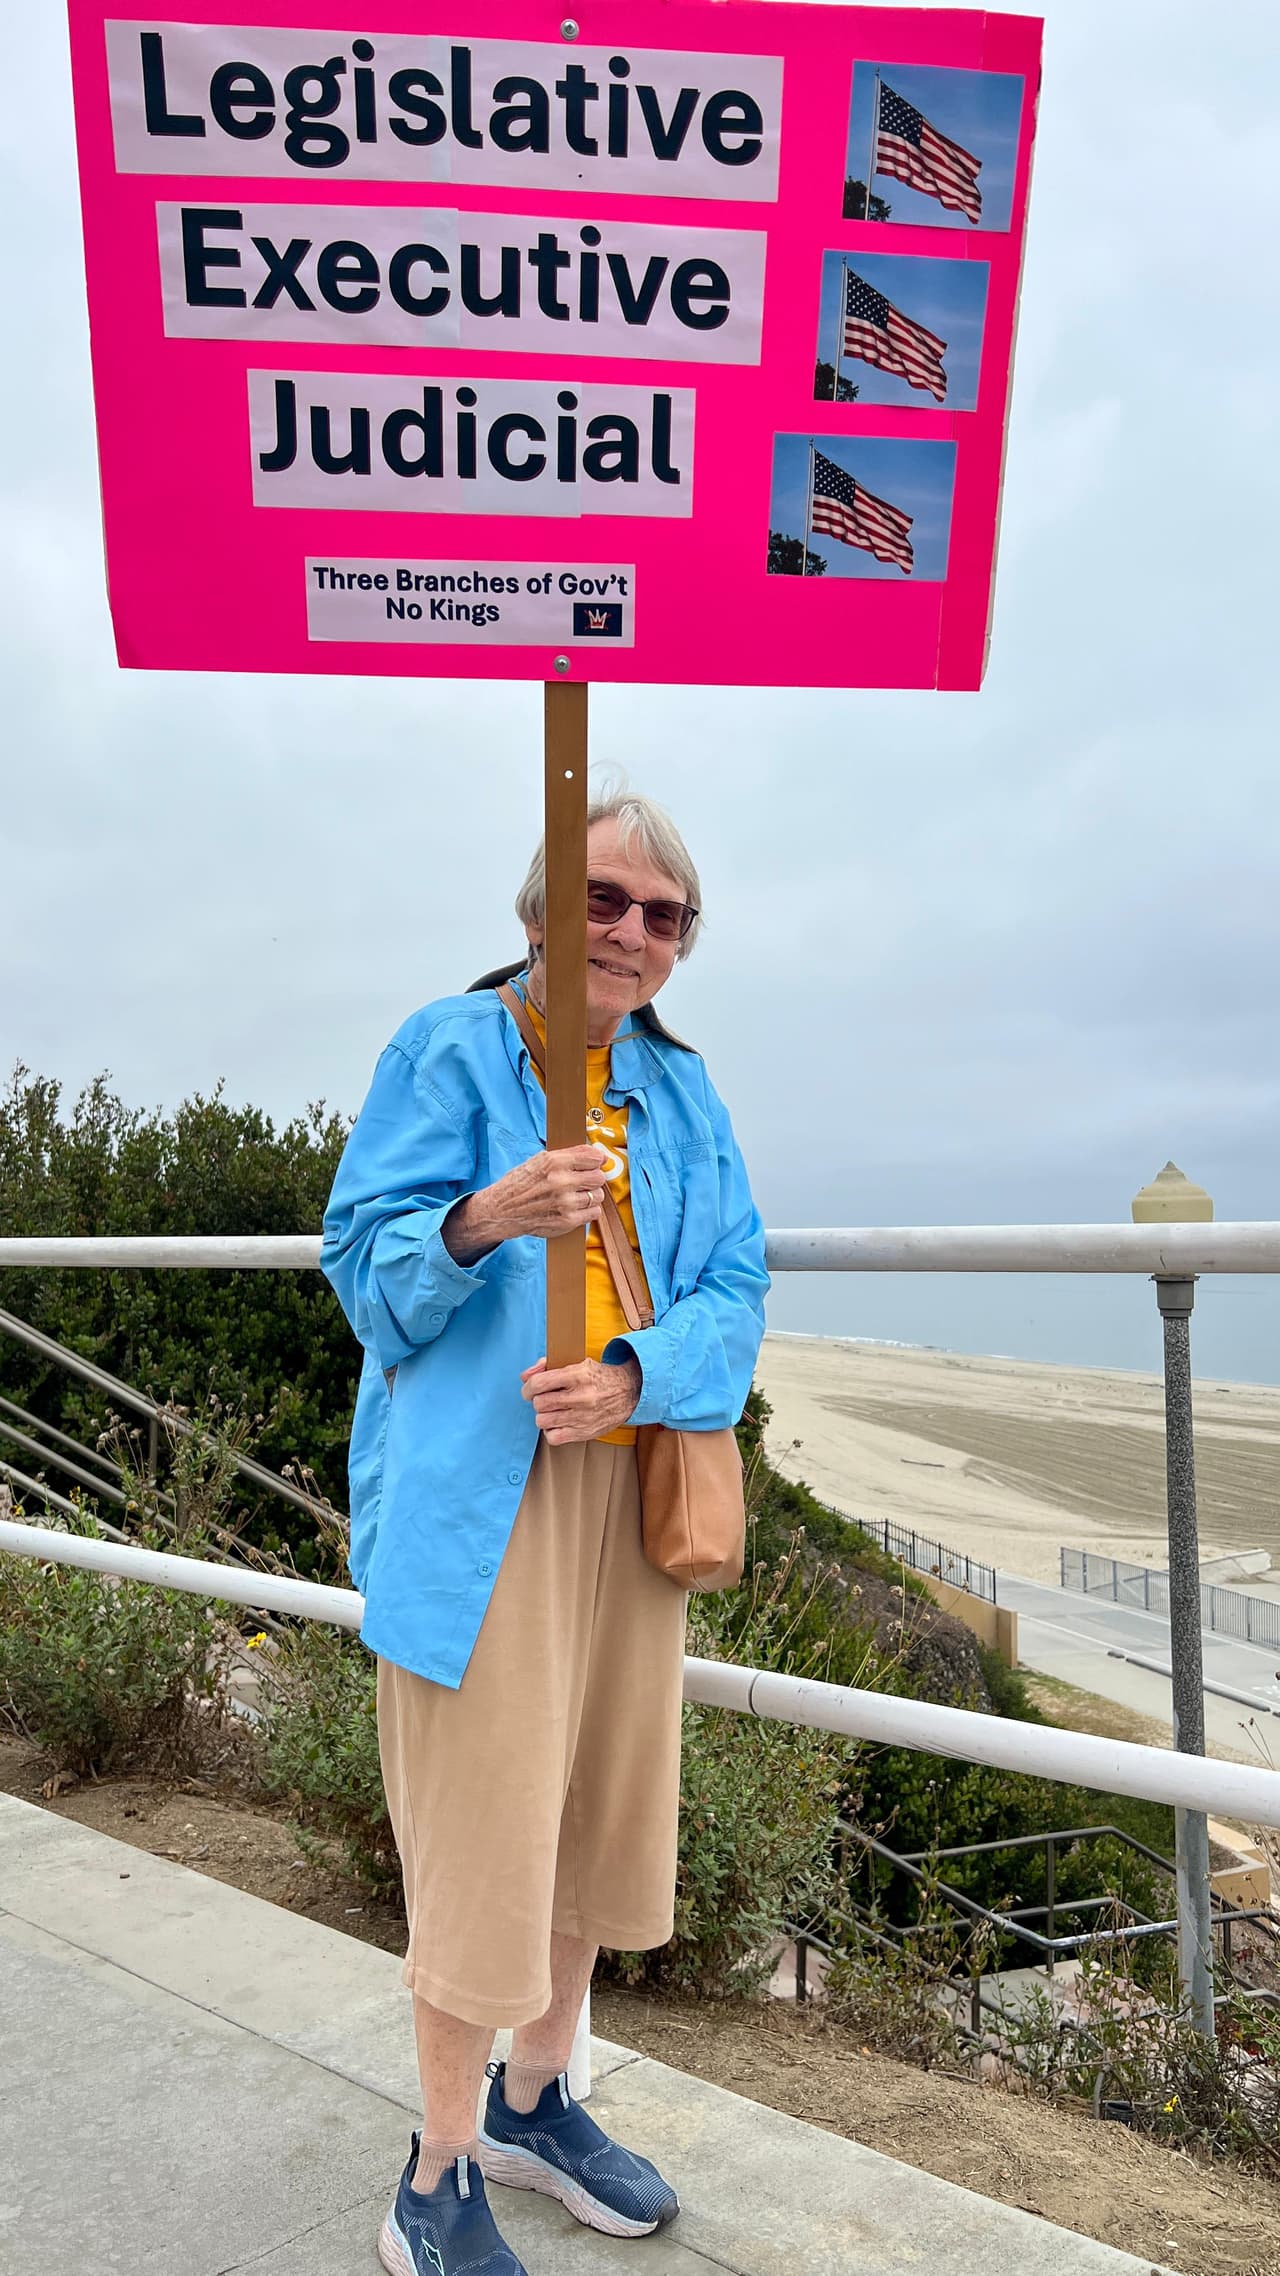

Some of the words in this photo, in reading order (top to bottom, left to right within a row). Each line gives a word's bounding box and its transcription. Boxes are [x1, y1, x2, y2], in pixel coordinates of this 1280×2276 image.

[140, 32, 763, 168] Legislative
[181, 208, 731, 330] Executive
[260, 380, 680, 484] Judicial
[312, 566, 389, 591] Three
[396, 568, 520, 594] Branches
[526, 572, 553, 595] of
[558, 572, 628, 597] Gov't
[385, 597, 423, 620] No
[429, 598, 500, 627] Kings
